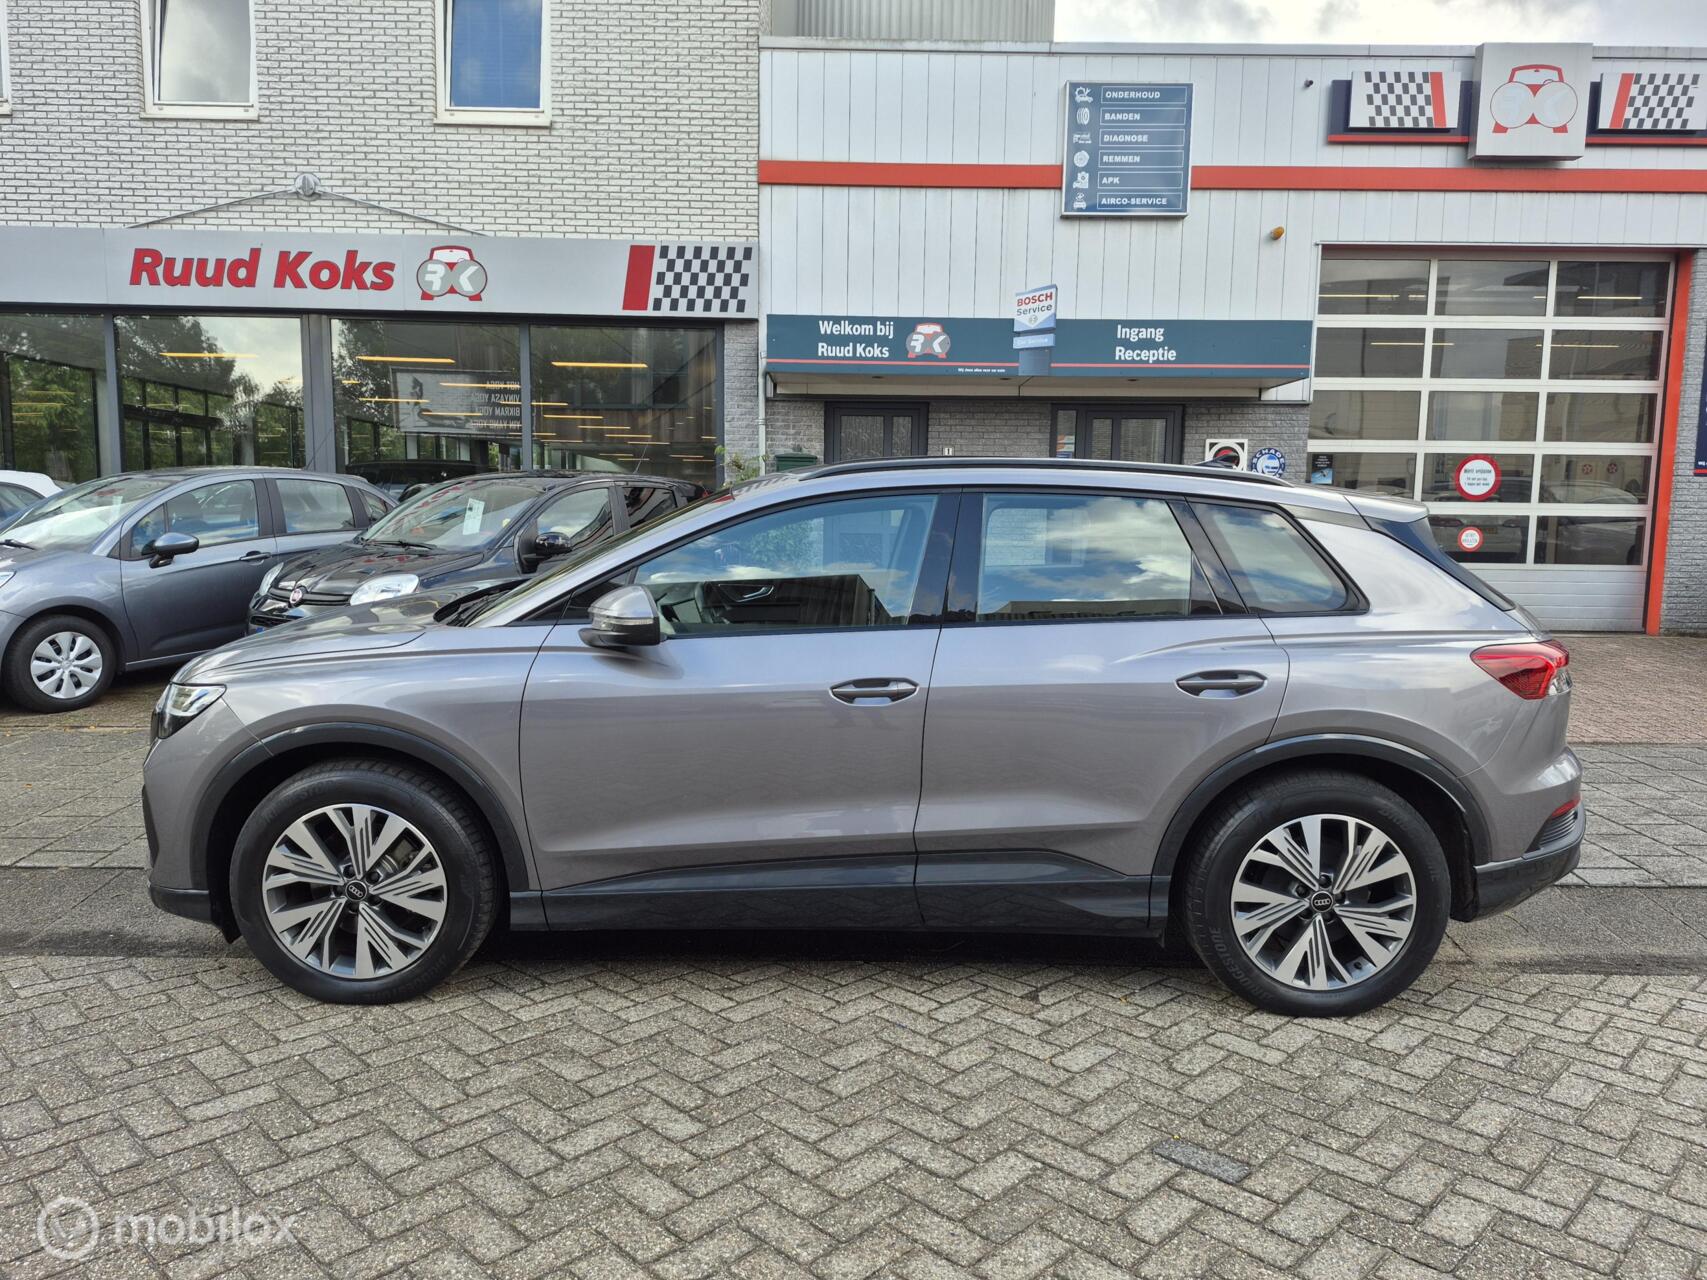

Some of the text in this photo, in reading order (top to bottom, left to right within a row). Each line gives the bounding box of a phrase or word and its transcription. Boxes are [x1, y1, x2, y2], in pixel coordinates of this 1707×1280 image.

[1105, 91, 1161, 99] ONDERHOUD
[1103, 134, 1149, 142] DIAGNOSE
[1102, 155, 1141, 163] REMMEN
[1101, 197, 1168, 205] AIRCO-SERVICE
[129, 247, 396, 291] Ruud Koks
[1017, 291, 1053, 307] BOSCH
[1016, 303, 1053, 317] Service
[818, 320, 894, 339] Welkom bij
[1116, 324, 1165, 342] Ingang
[817, 342, 890, 358] Ruud Koks
[1115, 346, 1177, 364] Receptie
